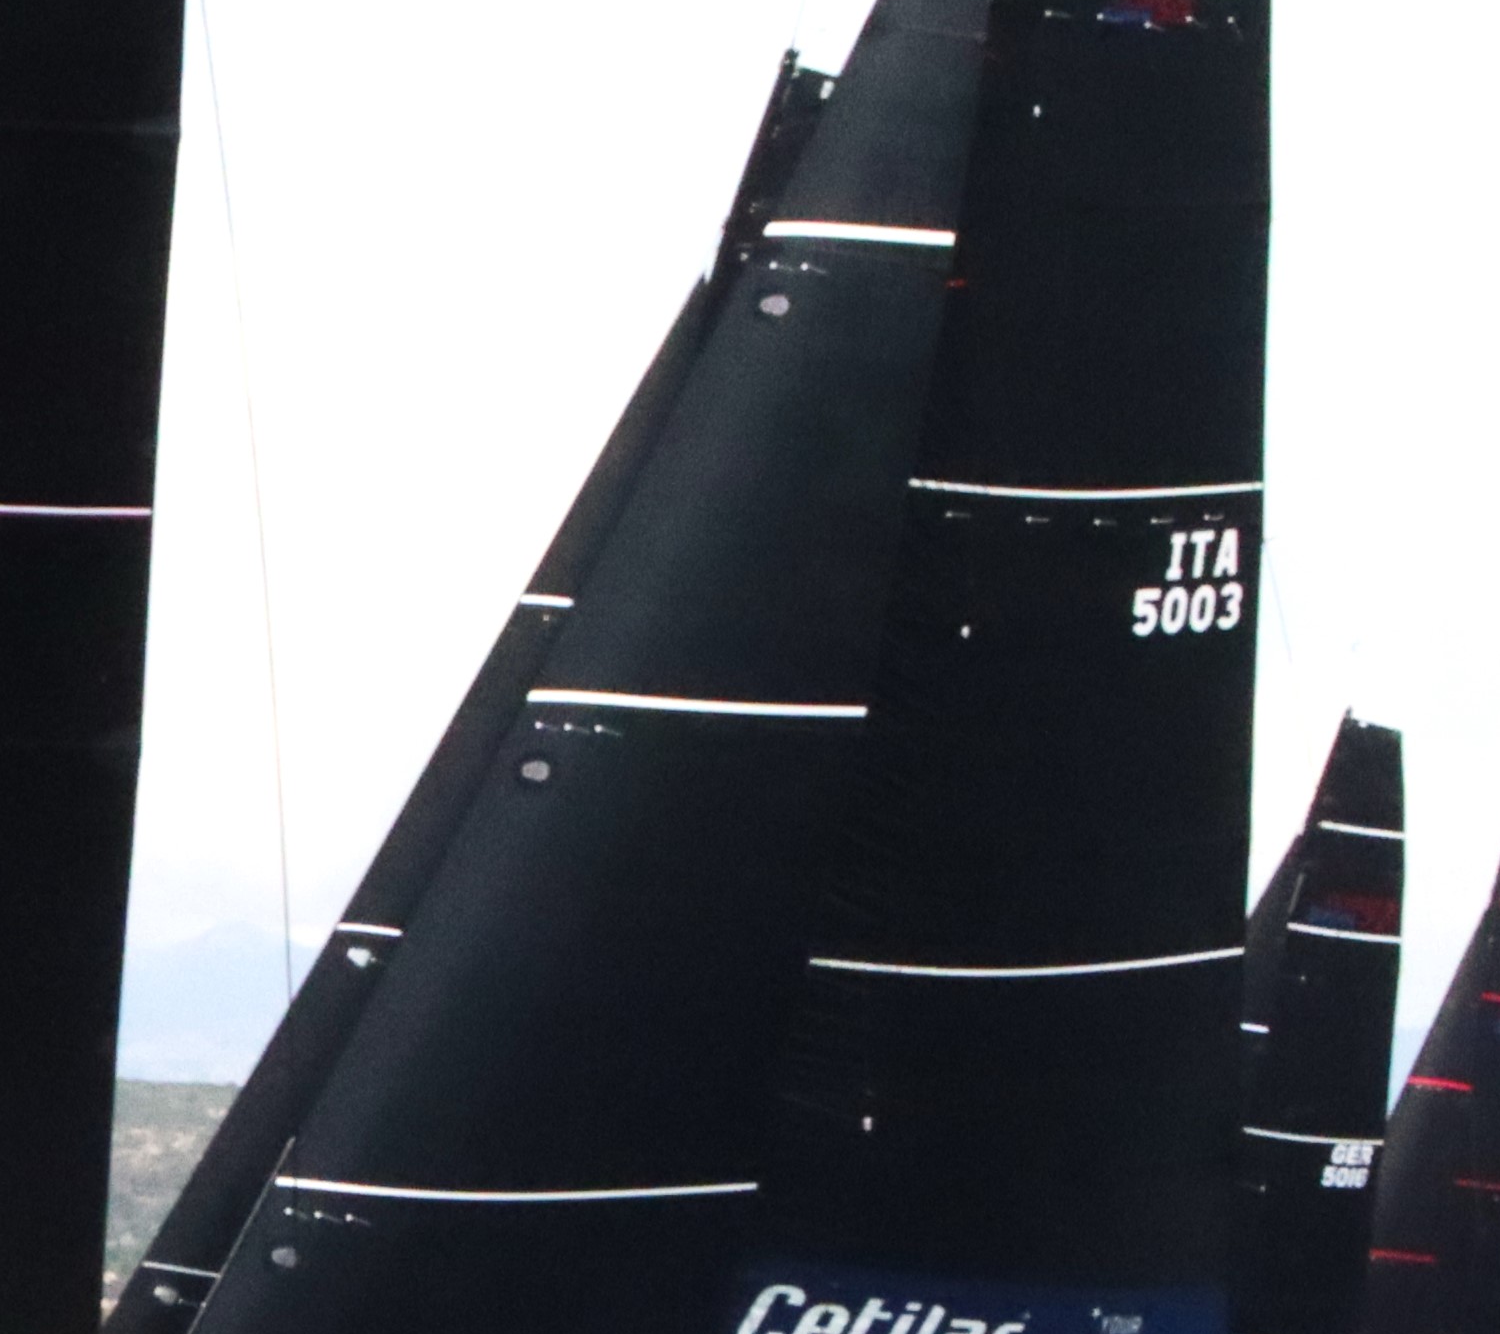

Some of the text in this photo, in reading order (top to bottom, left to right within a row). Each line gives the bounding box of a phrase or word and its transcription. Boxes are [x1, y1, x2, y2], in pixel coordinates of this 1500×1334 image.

[1164, 528, 1240, 581] ITA
[1132, 581, 1243, 637] 5003
[1330, 1144, 1374, 1165] GER
